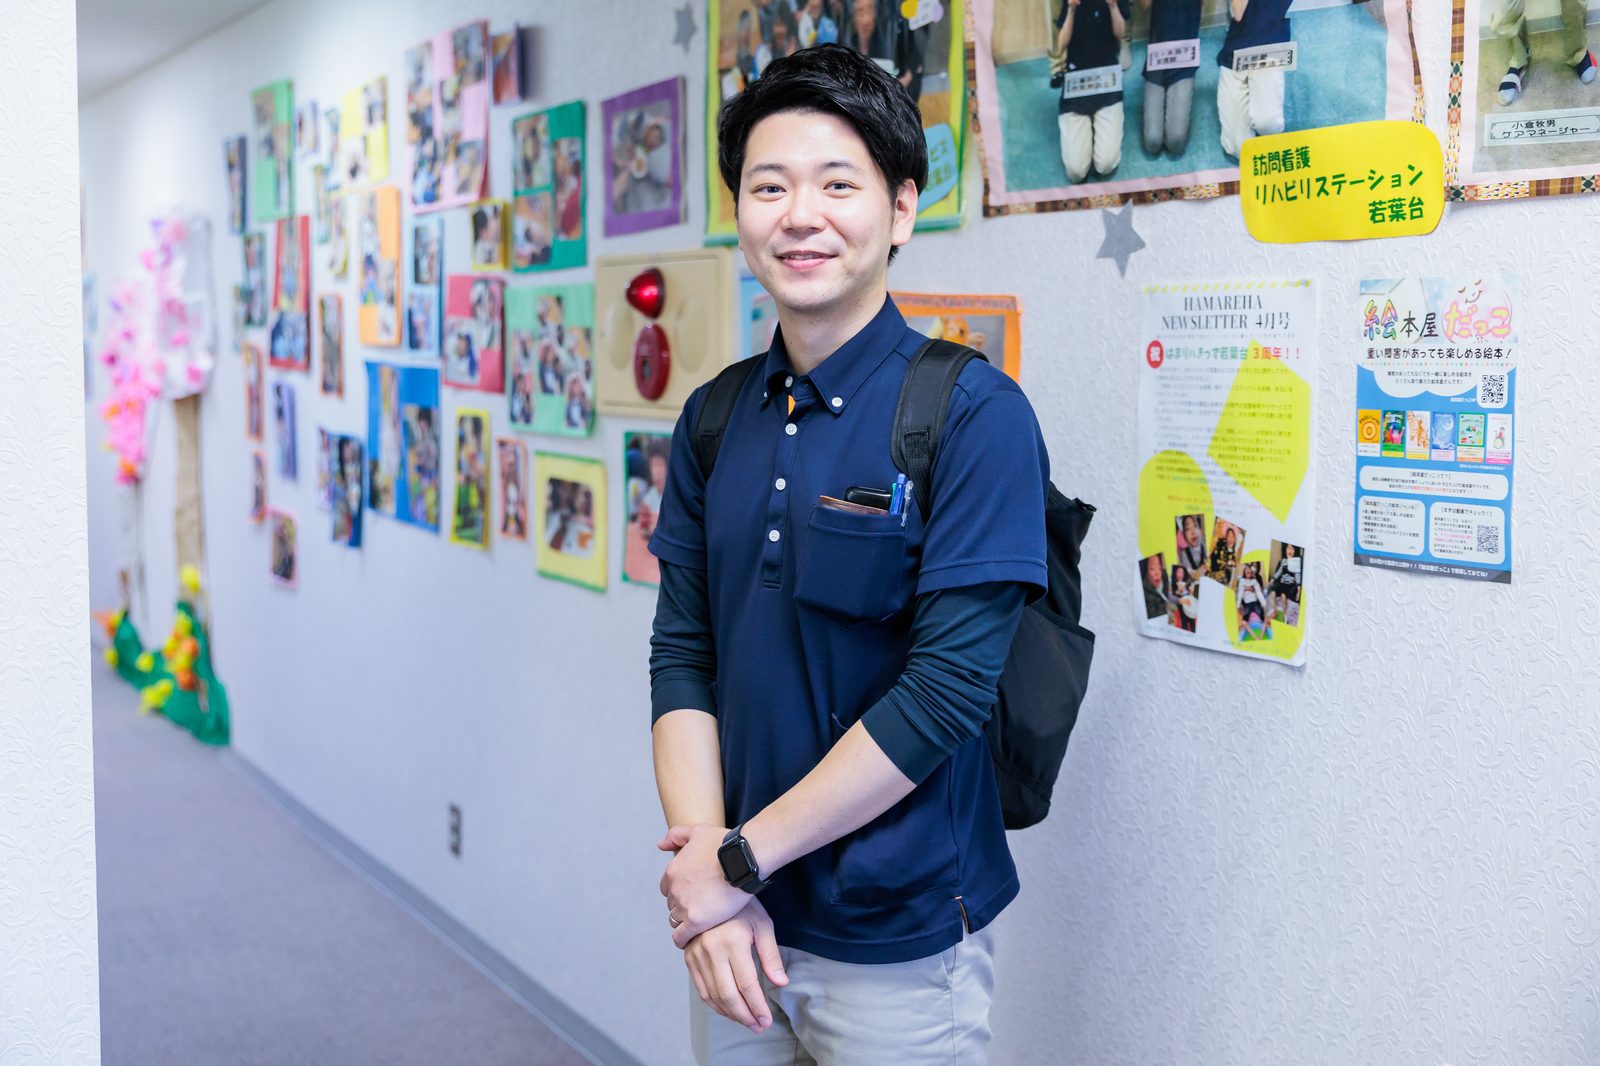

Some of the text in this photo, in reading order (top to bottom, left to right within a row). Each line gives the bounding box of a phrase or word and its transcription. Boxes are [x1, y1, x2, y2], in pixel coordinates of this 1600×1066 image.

[1502, 127, 1590, 138] ケアマネージャー
[1512, 119, 1556, 129] 小倉牧男
[1253, 146, 1311, 176] 訪問看護
[1255, 164, 1424, 205] リハビリステーション
[1368, 196, 1424, 224] 若葉台
[1184, 295, 1263, 312] HAMAREHA
[1162, 312, 1291, 330] NEWSLETTER 4月号
